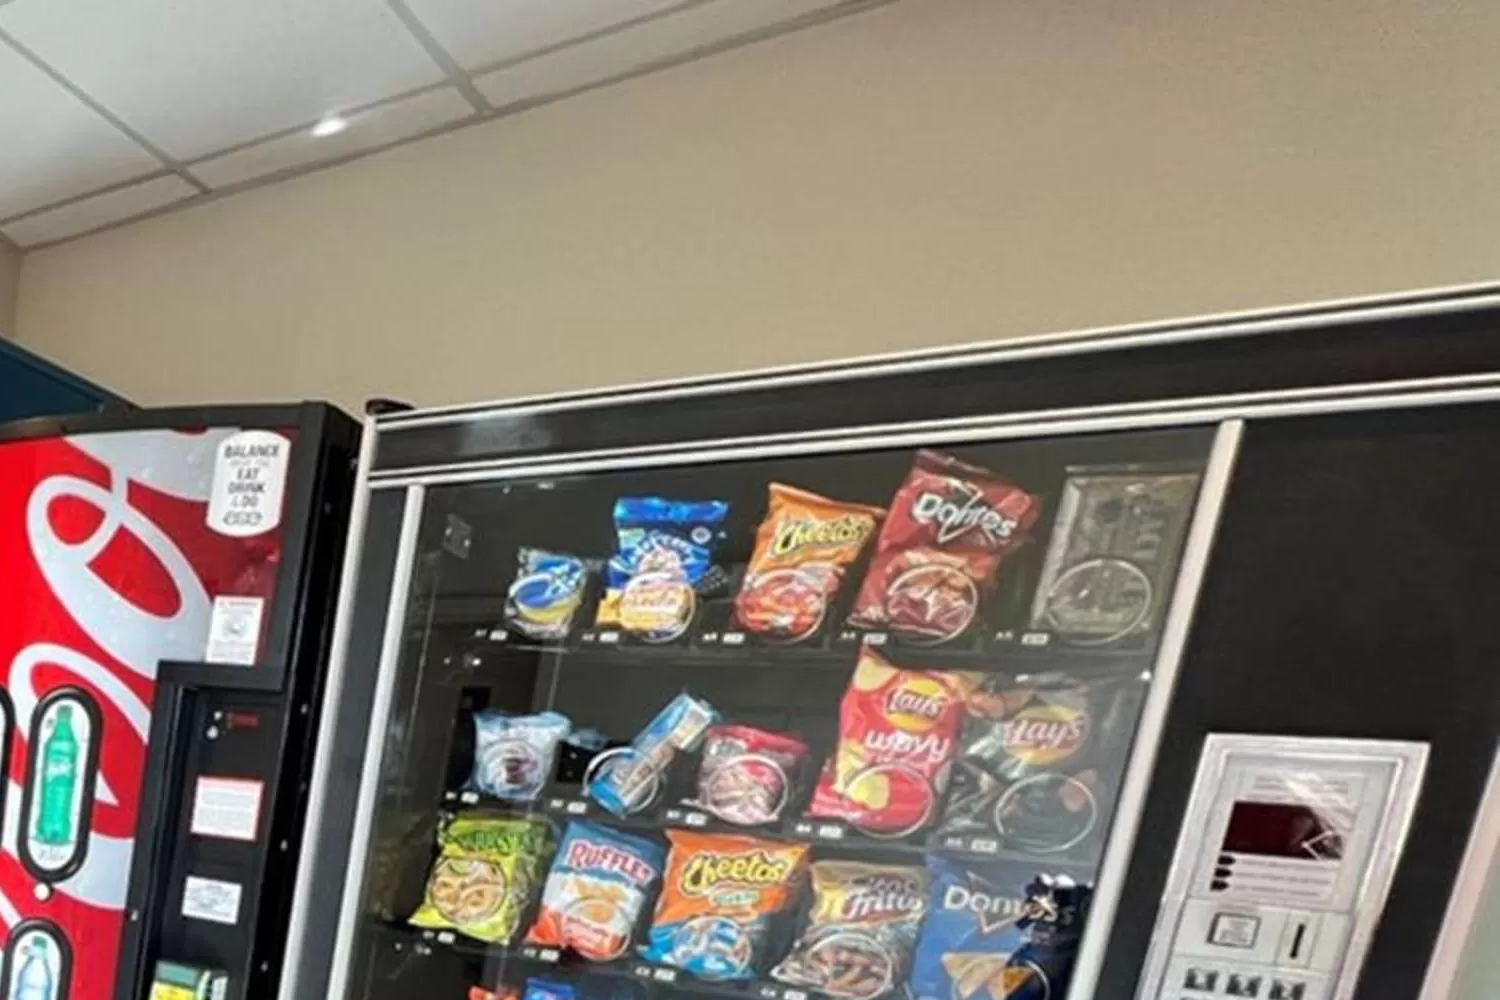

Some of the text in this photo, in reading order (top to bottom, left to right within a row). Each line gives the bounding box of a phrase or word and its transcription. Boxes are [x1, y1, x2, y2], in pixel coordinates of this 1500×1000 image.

[224, 444, 280, 458] BALANCE
[228, 482, 266, 494] DRINK
[237, 467, 260, 480] EAT
[912, 491, 1018, 540] Doritos
[773, 518, 870, 556] Cheetos
[568, 842, 655, 886] RUFFLES
[682, 852, 787, 893] Cheetos
